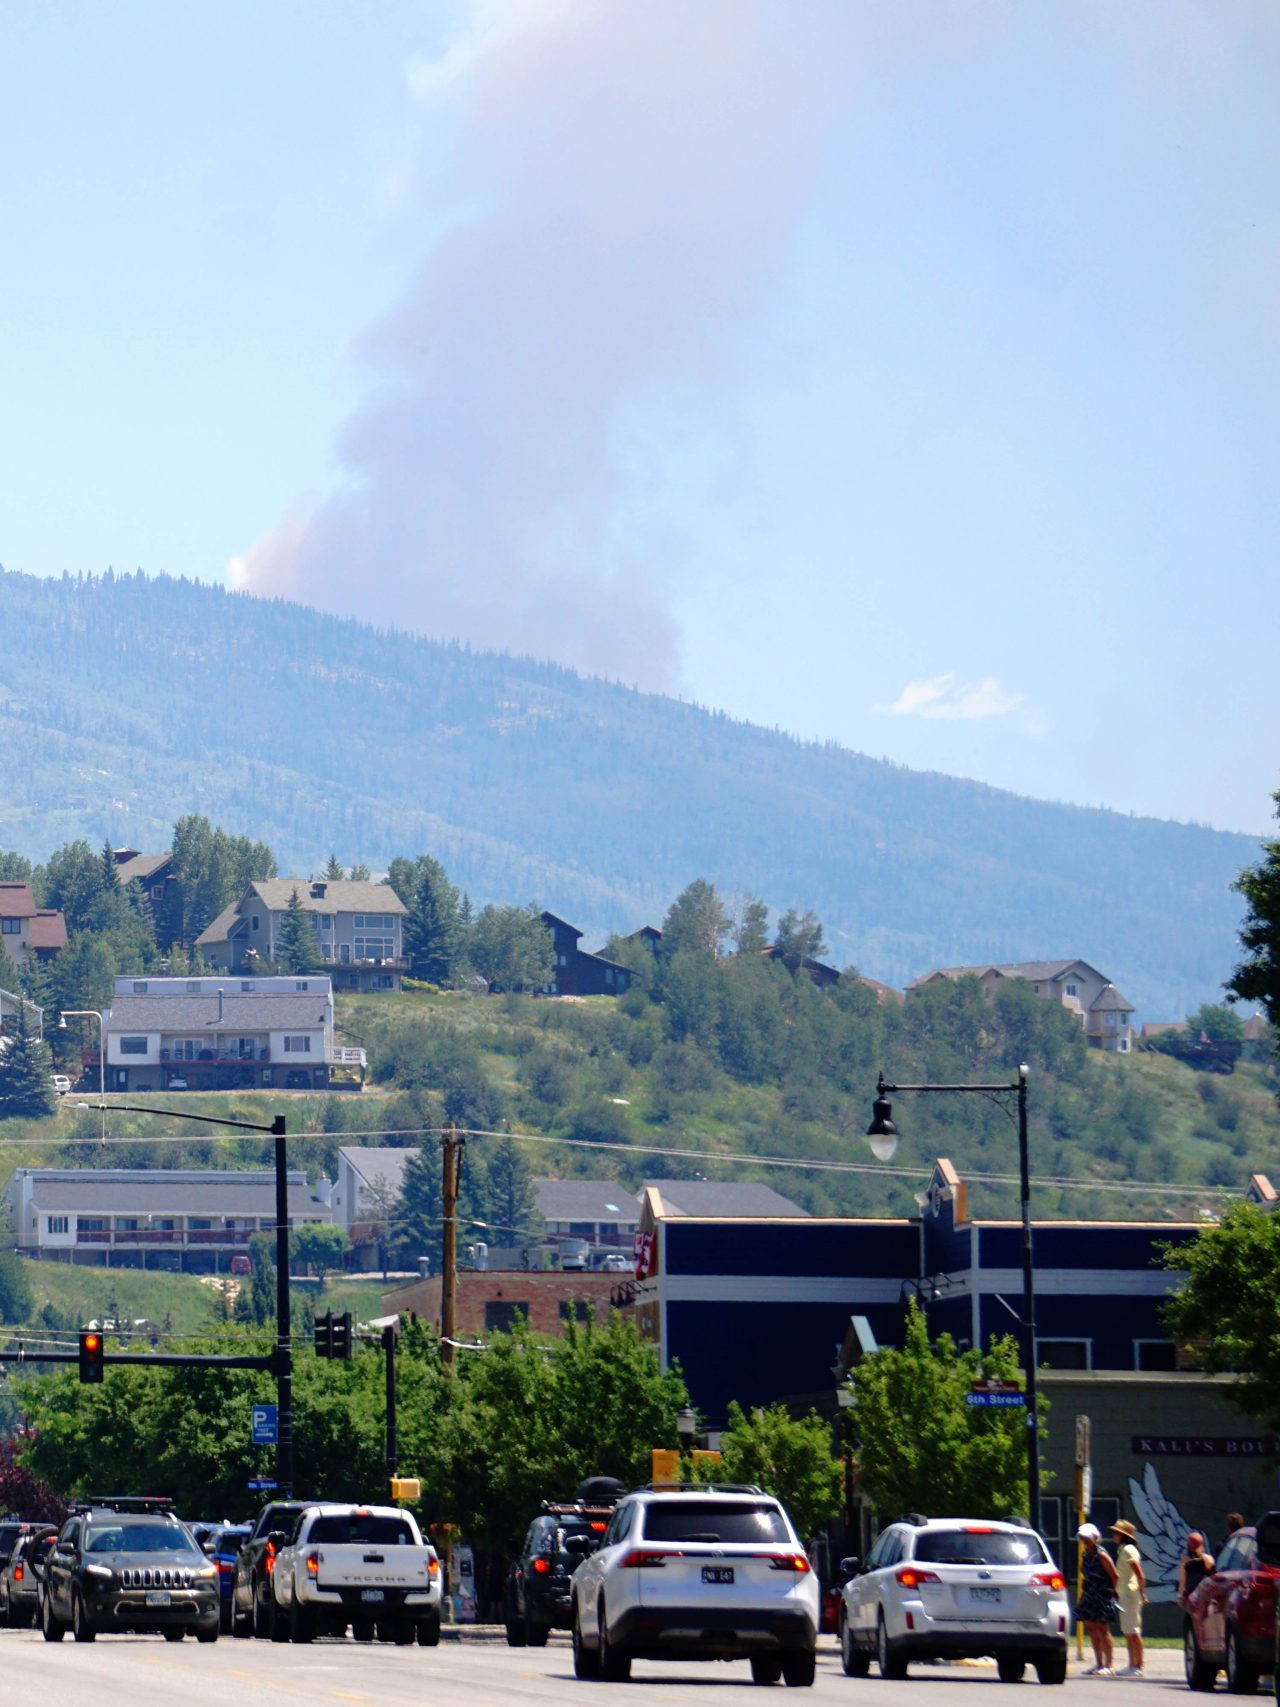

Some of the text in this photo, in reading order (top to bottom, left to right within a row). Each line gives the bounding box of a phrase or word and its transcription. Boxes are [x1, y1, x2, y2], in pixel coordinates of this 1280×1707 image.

[989, 1394, 1024, 1405] Street
[1140, 1440, 1215, 1453] KALI'S
[342, 1575, 406, 1583] TACOMA
